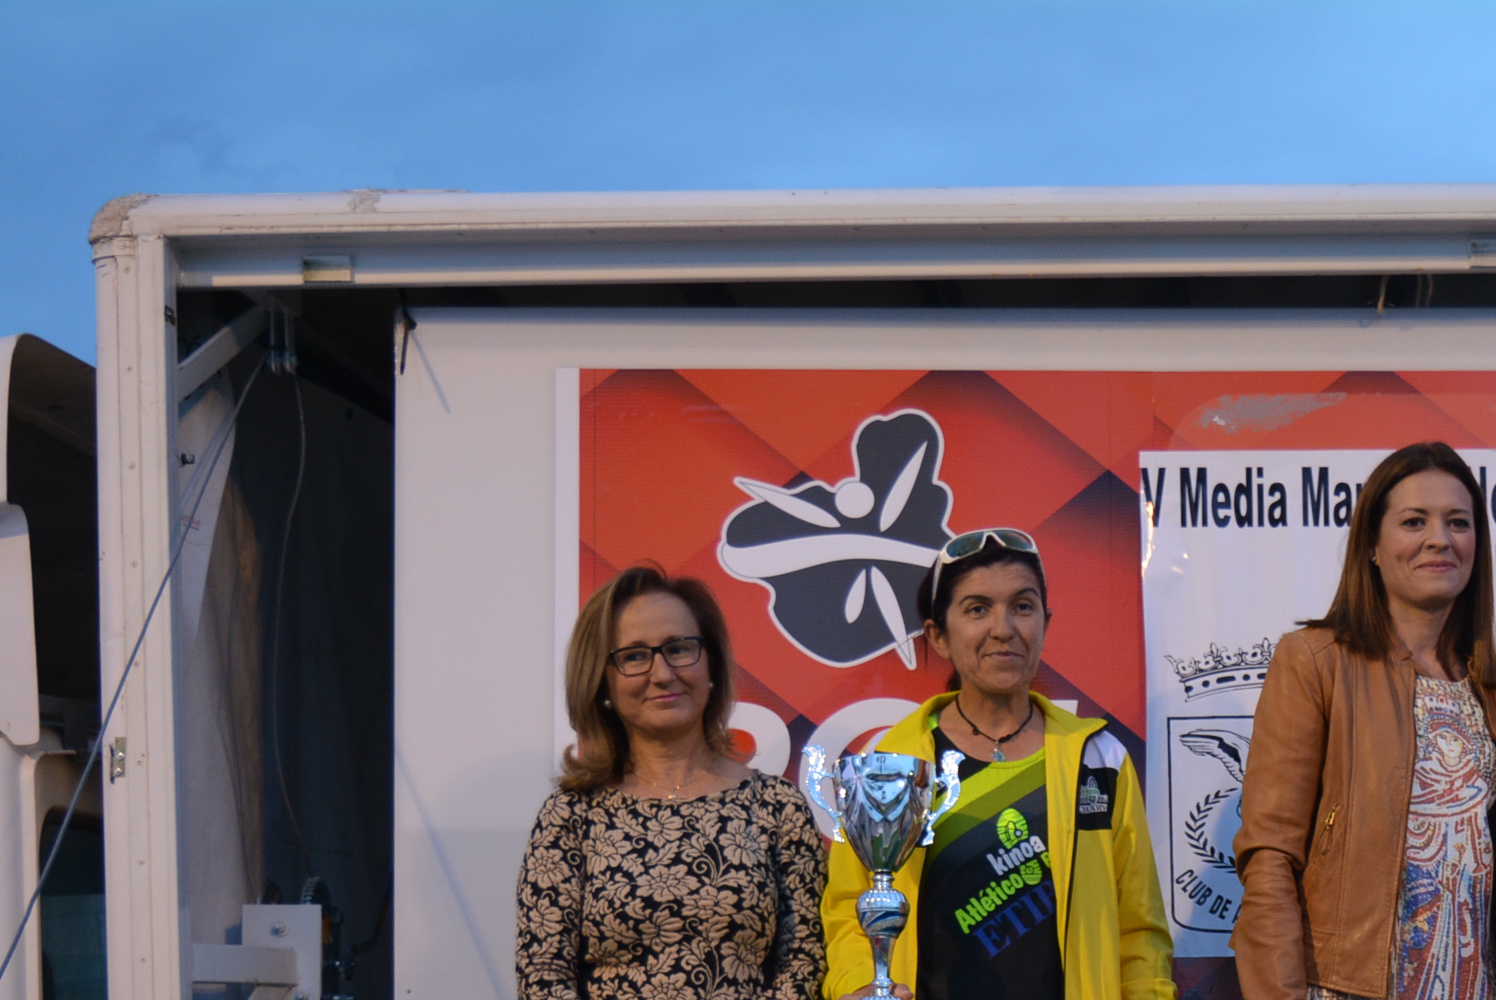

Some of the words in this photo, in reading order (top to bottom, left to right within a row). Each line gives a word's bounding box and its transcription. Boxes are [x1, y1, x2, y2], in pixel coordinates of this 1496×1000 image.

[1141, 467, 1166, 528] V
[1180, 466, 1288, 528] Media
[986, 835, 1046, 876] kinoa
[955, 873, 1024, 935] Atlético
[1175, 869, 1213, 907] CLUB
[1208, 894, 1233, 920] DE
